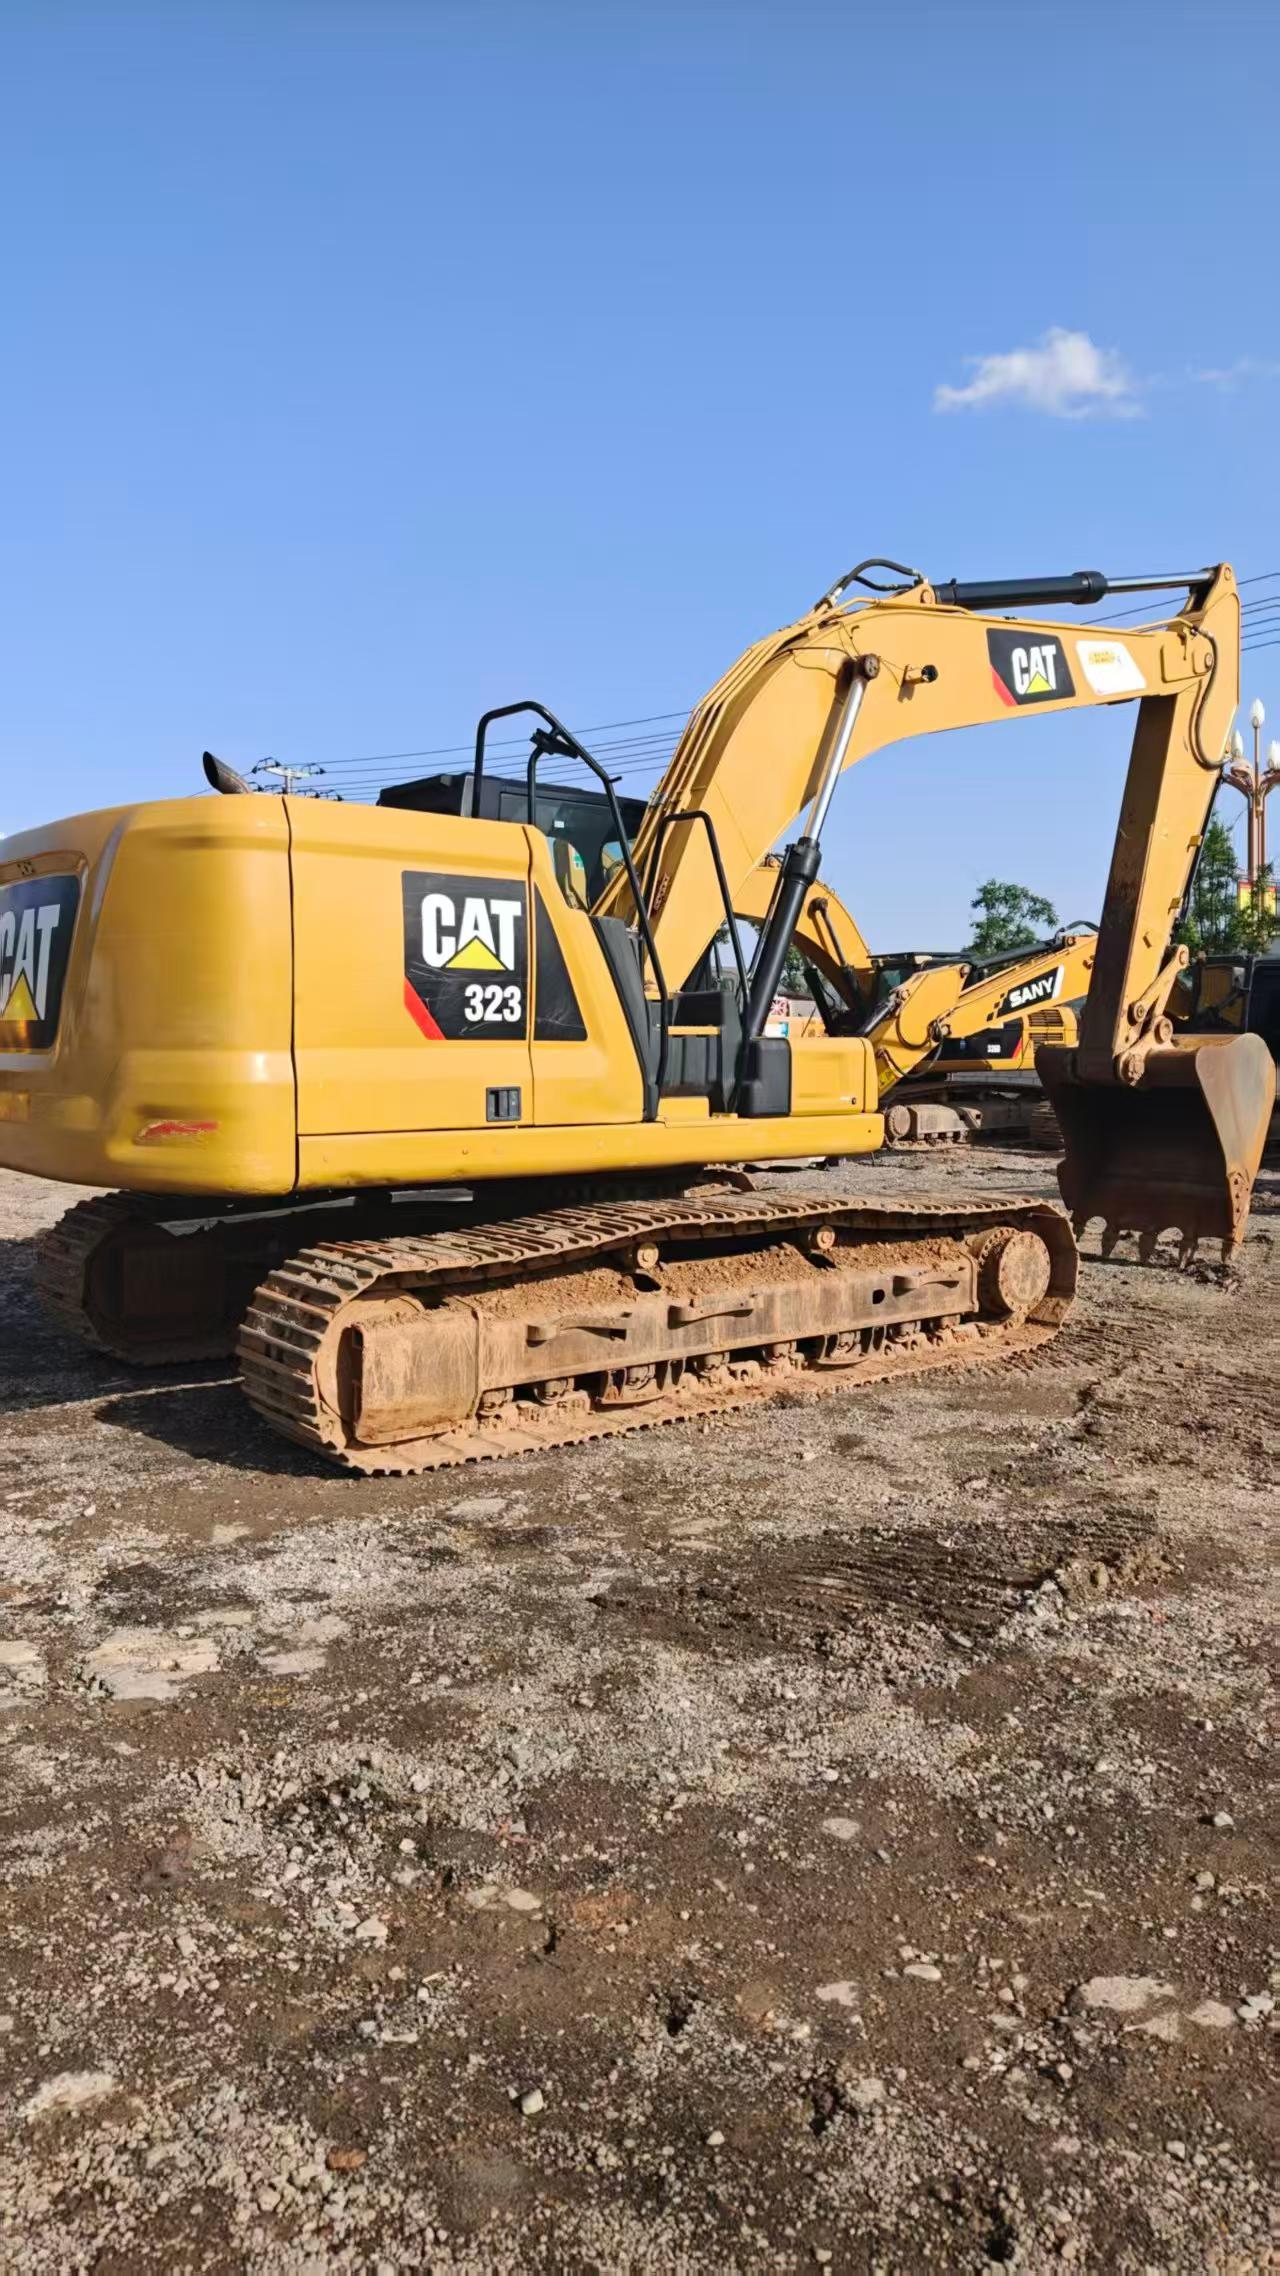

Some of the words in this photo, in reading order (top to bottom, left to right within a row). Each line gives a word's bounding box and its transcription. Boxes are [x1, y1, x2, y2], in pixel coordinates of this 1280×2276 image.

[1011, 645, 1056, 695] CAT
[422, 893, 522, 971] CAT
[464, 984, 522, 1022] 323
[1009, 976, 1054, 1008] SANY
